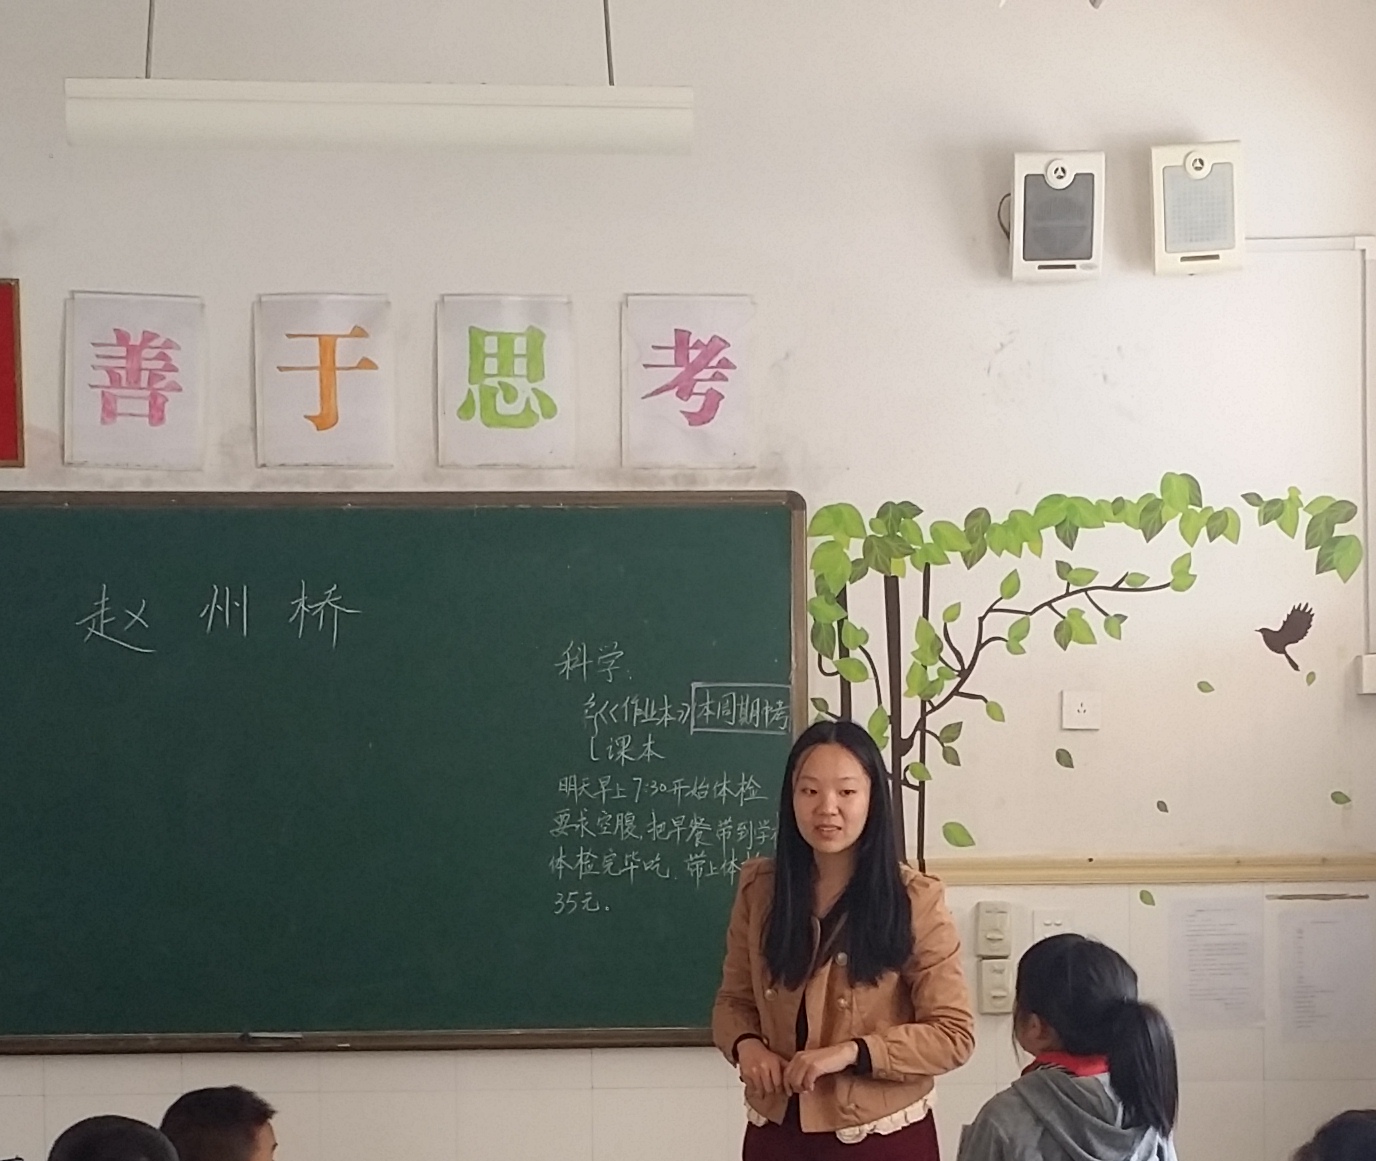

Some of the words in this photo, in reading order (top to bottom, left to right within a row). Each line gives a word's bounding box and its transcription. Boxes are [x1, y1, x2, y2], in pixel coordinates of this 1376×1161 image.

[89, 324, 737, 430] 善于思考
[76, 579, 362, 652] 赵州桥
[606, 733, 665, 766] 课本
